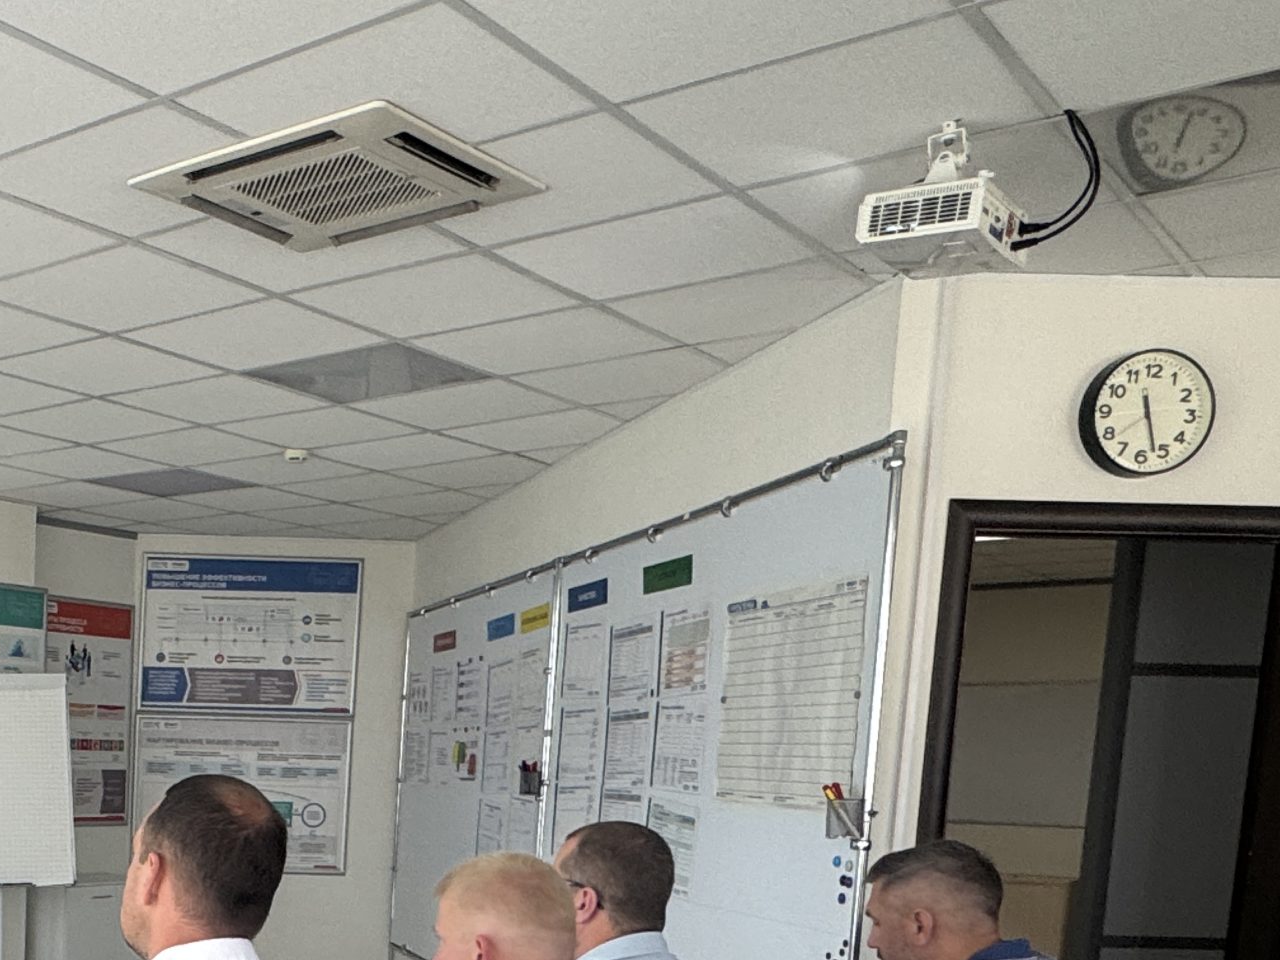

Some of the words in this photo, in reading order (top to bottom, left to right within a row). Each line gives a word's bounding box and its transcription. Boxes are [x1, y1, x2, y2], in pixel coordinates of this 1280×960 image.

[1126, 369, 1139, 384] 11
[1145, 364, 1163, 379] 12
[1171, 372, 1178, 386] 1
[1108, 384, 1126, 399] 10
[1180, 388, 1192, 403] 2
[1098, 404, 1112, 419] 9
[1183, 409, 1197, 424] 3
[1102, 426, 1115, 441] 8
[1173, 431, 1186, 444] 4
[1117, 442, 1129, 457] 7
[1134, 450, 1148, 464] 6
[1156, 444, 1170, 459] 5
